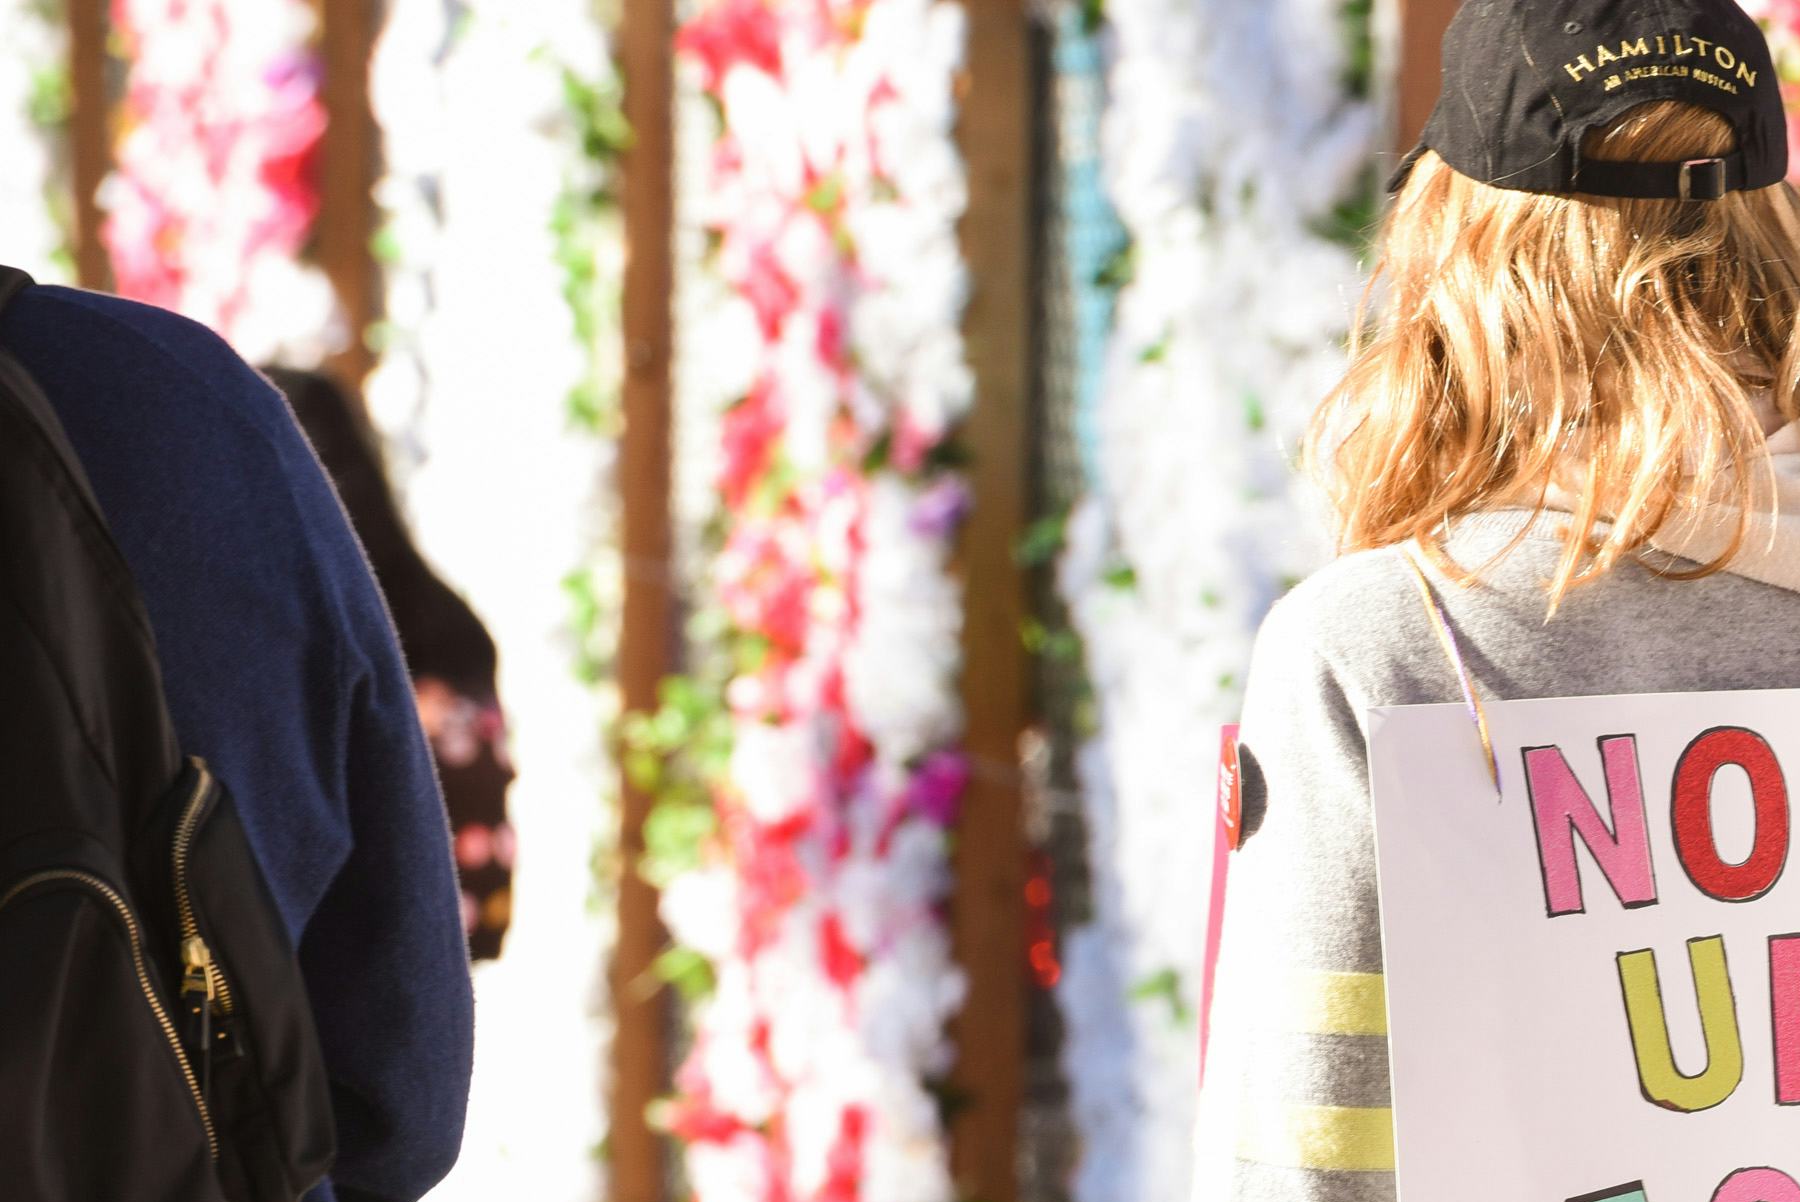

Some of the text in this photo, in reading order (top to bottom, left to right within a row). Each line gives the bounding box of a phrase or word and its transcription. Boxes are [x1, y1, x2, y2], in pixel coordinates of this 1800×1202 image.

[1563, 34, 1758, 88] HAMILTON
[1624, 65, 1689, 82] AMERICAN
[1692, 68, 1739, 95] MUSICAL
